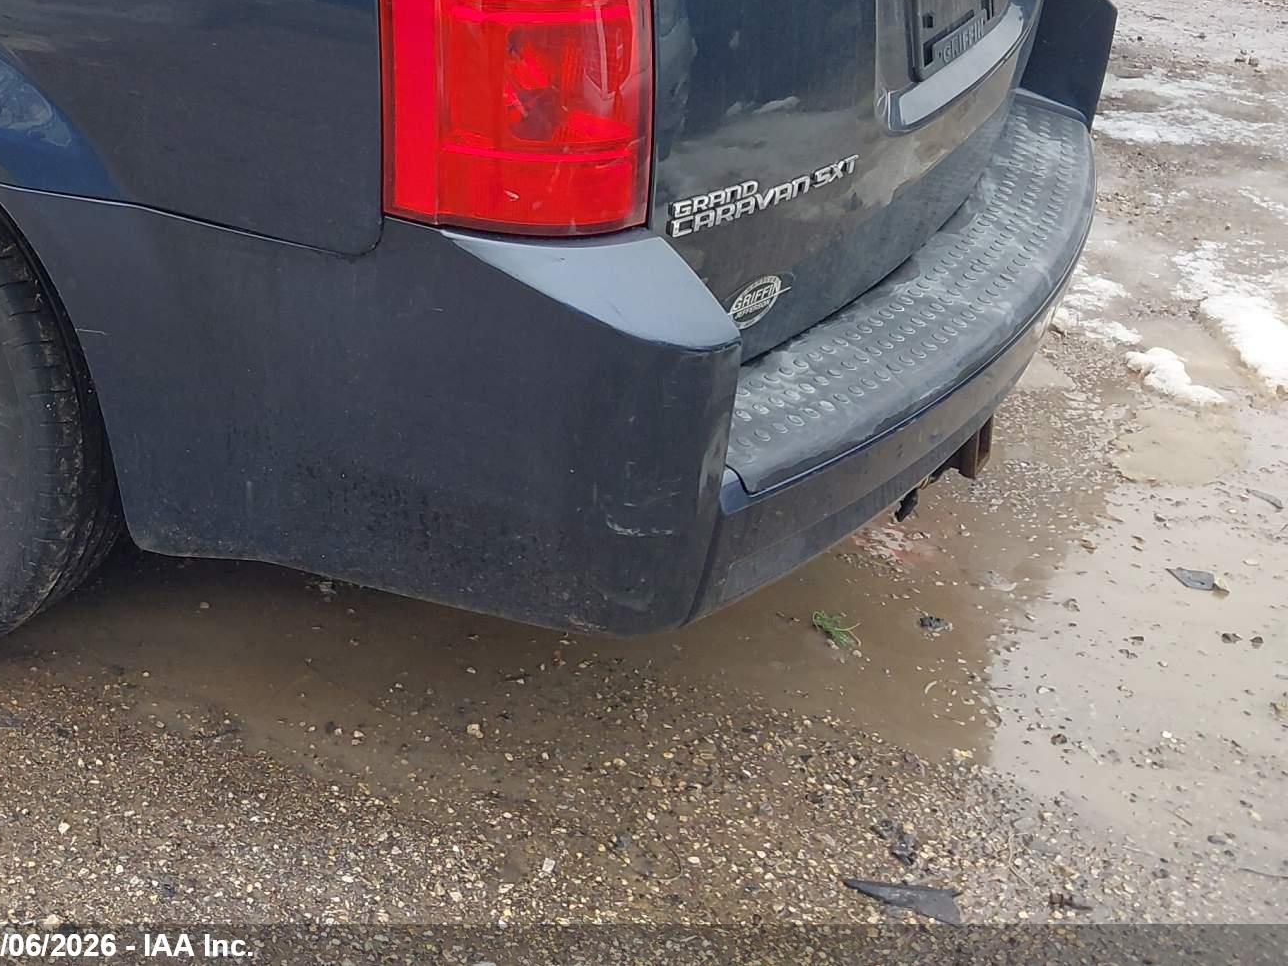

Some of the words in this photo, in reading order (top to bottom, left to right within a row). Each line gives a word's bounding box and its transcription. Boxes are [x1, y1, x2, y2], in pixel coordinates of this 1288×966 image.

[943, 17, 984, 64] GRIFFIN
[669, 175, 811, 238] CARAVAN
[812, 154, 860, 188] SXT
[671, 180, 759, 219] GRAND
[732, 282, 780, 311] GRIFFIN
